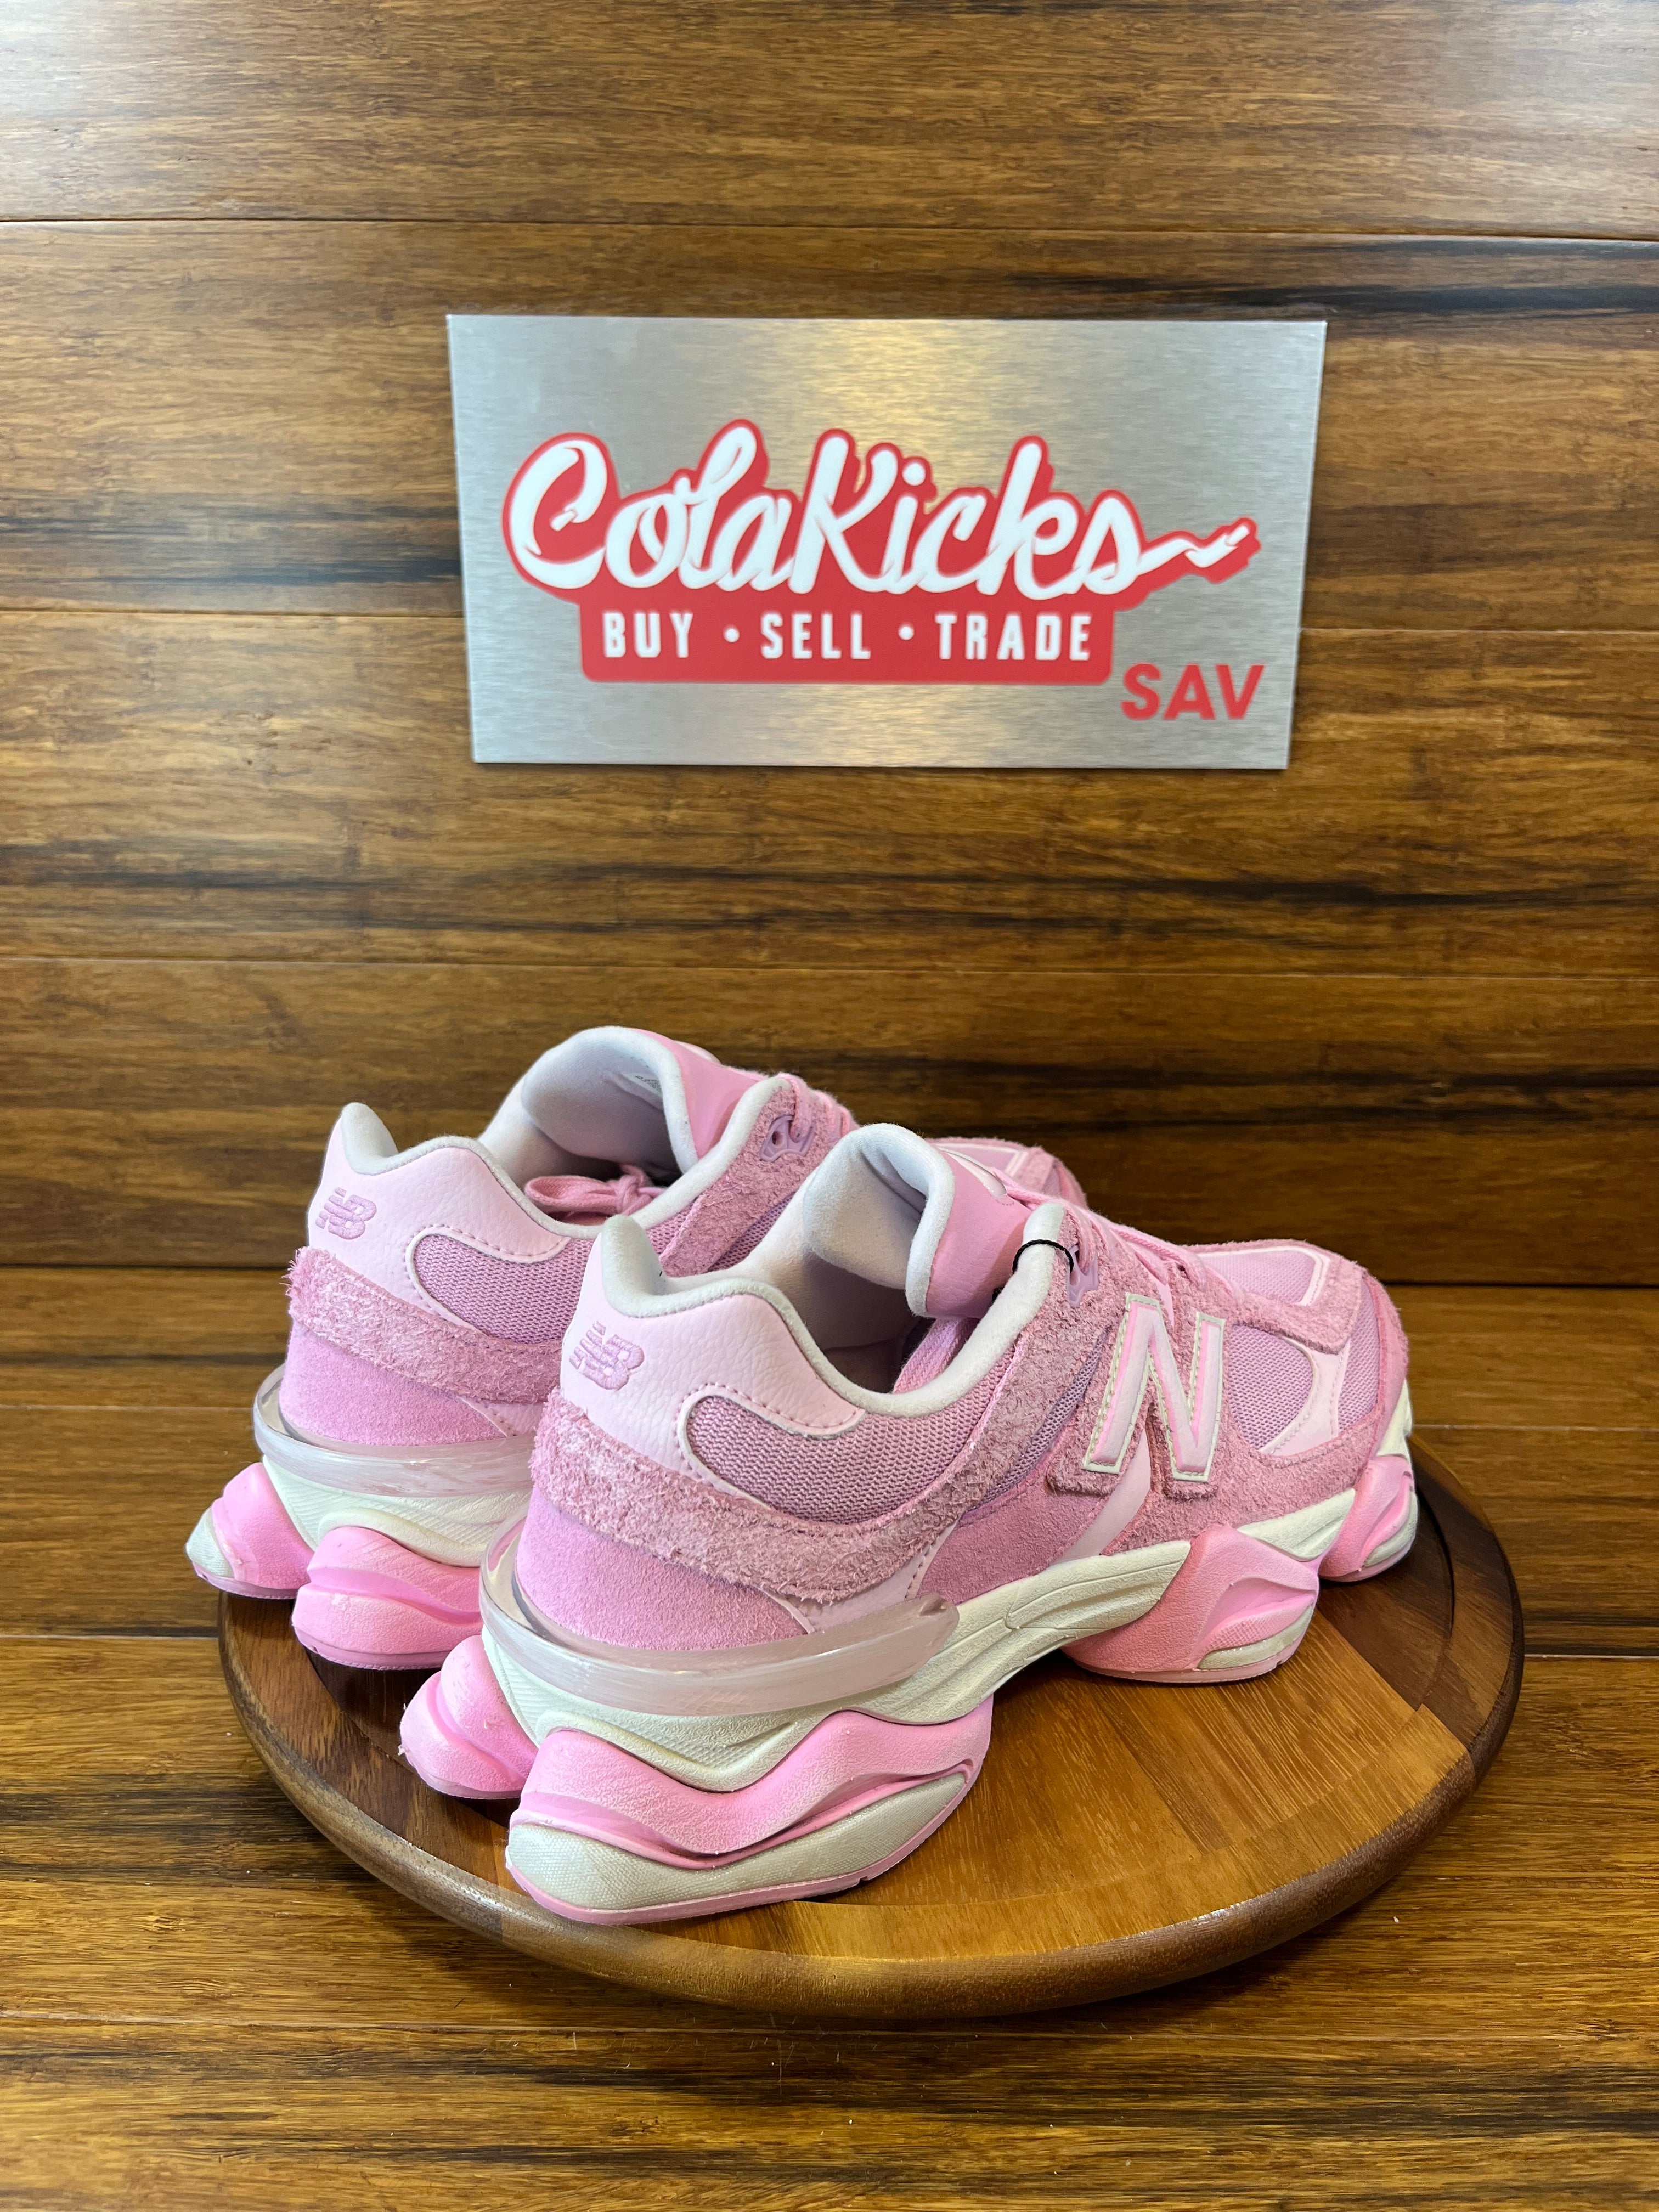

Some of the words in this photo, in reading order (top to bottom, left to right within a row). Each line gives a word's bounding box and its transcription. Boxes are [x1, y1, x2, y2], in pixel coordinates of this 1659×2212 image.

[508, 421, 1251, 600] ColaKicks
[603, 611, 693, 658] BUY
[761, 612, 871, 659] SELL
[935, 613, 1092, 661] TRADE
[1121, 663, 1265, 720] SAV
[1081, 1291, 1226, 1482] N
